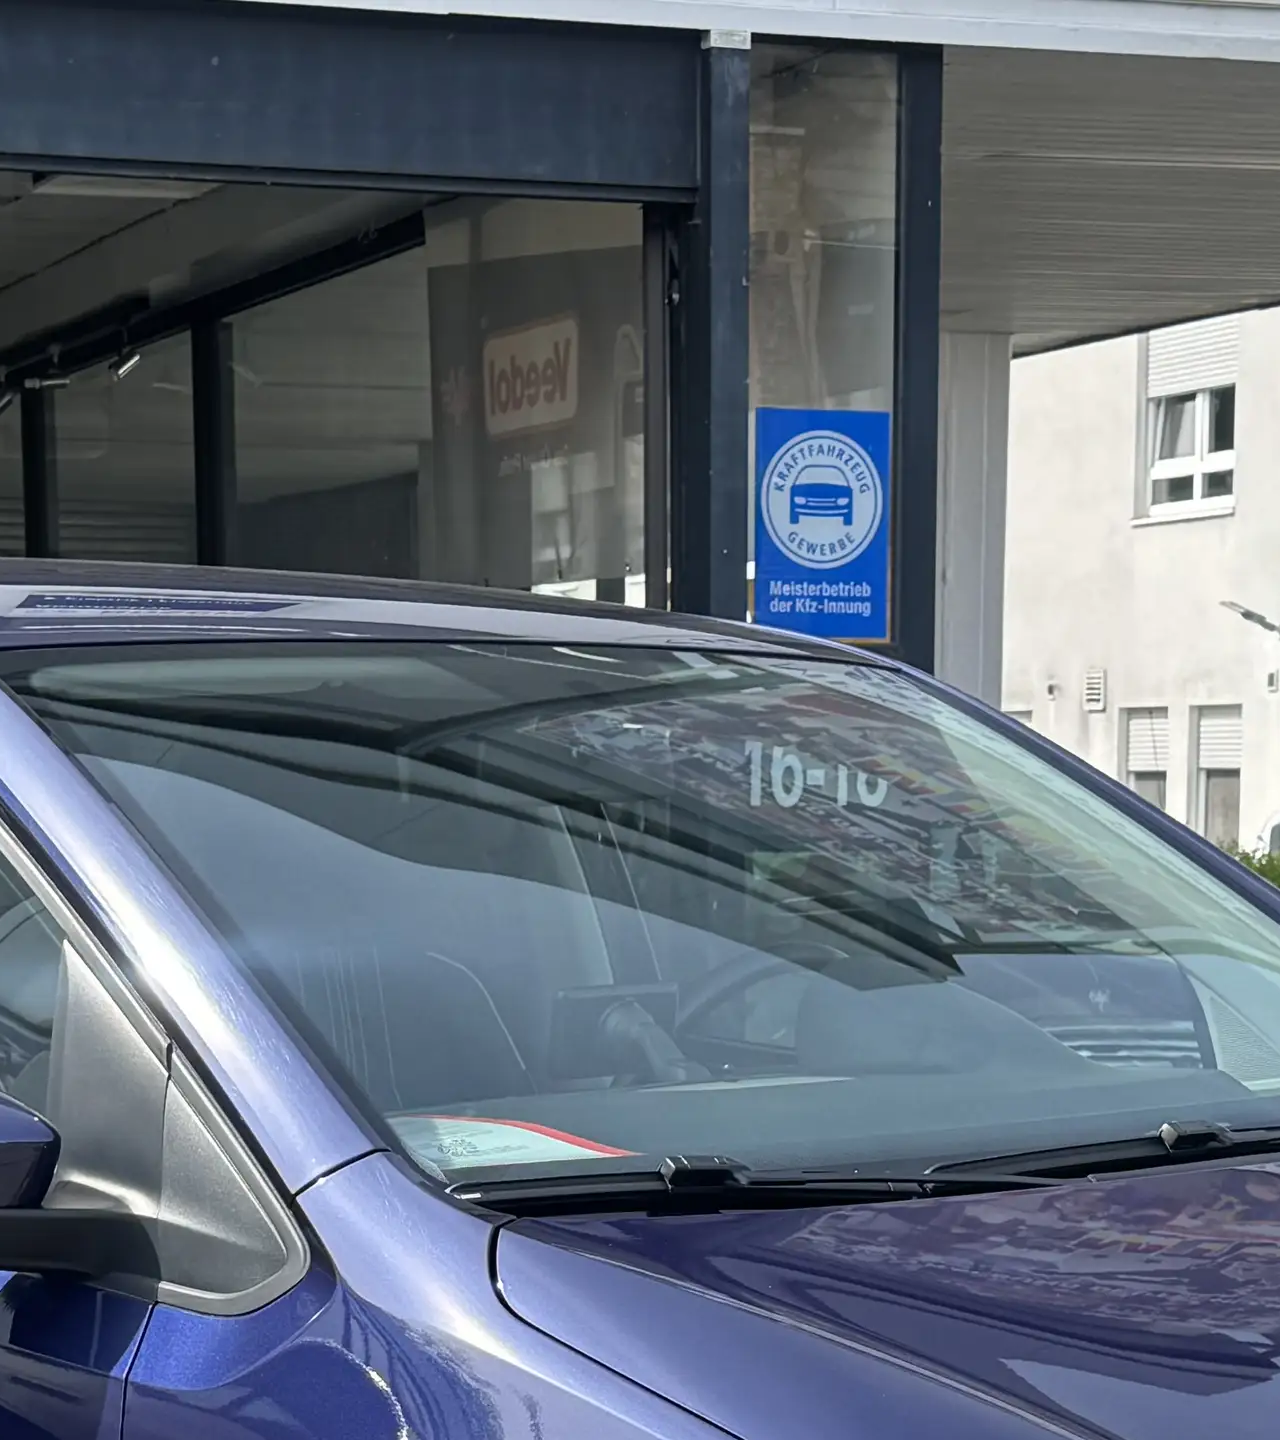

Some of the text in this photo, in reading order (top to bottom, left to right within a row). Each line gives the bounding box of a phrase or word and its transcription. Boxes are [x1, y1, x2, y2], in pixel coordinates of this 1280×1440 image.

[774, 443, 871, 495] KRAFTFAHRZEUG
[787, 531, 856, 557] GEWERBE
[769, 580, 871, 598] Meisterbetrieb
[769, 598, 871, 617] der Kfz-Innung
